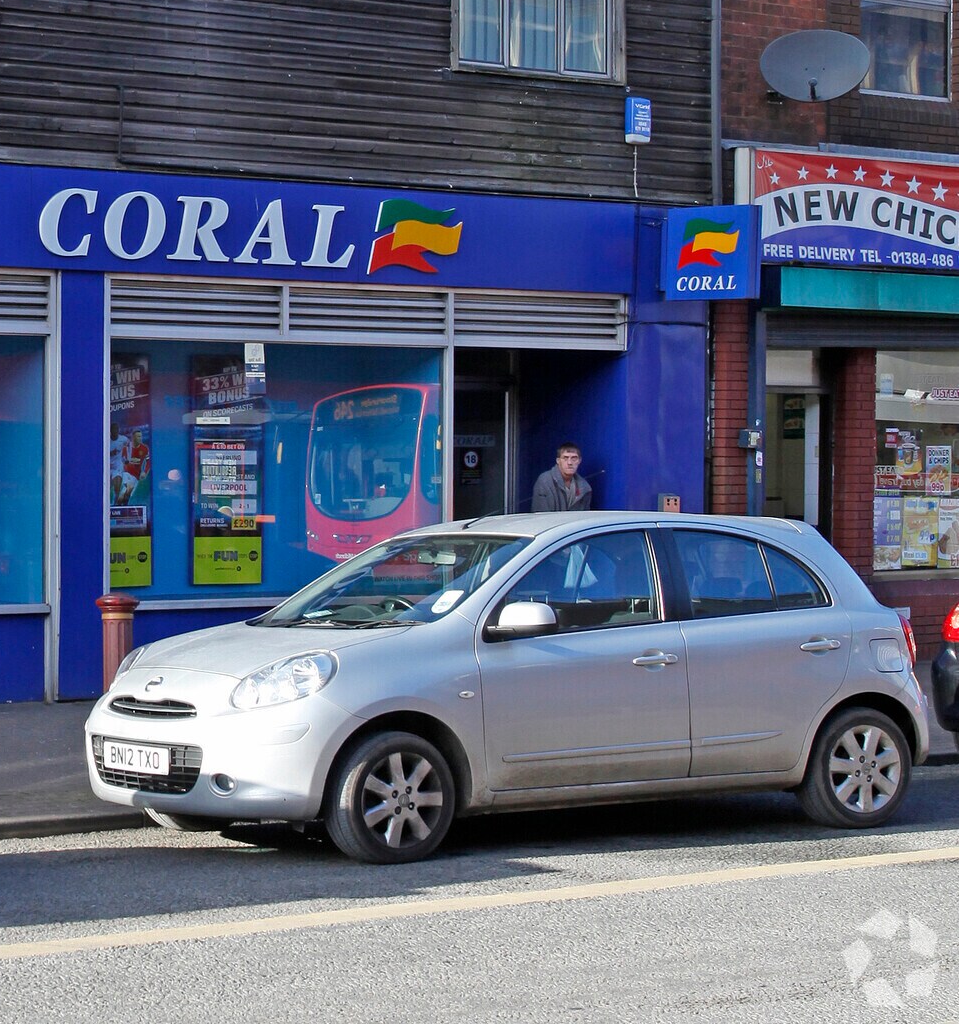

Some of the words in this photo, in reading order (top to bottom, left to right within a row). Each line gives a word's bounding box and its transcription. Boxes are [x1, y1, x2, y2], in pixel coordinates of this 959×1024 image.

[773, 190, 859, 227] NEW
[871, 196, 957, 245] CHIC
[38, 187, 356, 269] CORAL
[763, 243, 794, 258] FREE
[799, 245, 855, 262] DELIVERY
[860, 249, 881, 263] TEL
[676, 275, 737, 292] CORAL
[116, 368, 140, 385] WIN
[202, 376, 230, 391] 33%
[208, 386, 250, 405] BONUS
[932, 389, 948, 398] JUST
[213, 403, 254, 417] SCORECASTS
[466, 455, 476, 464] 18
[932, 483, 945, 492] 99p
[213, 551, 238, 561] FUN
